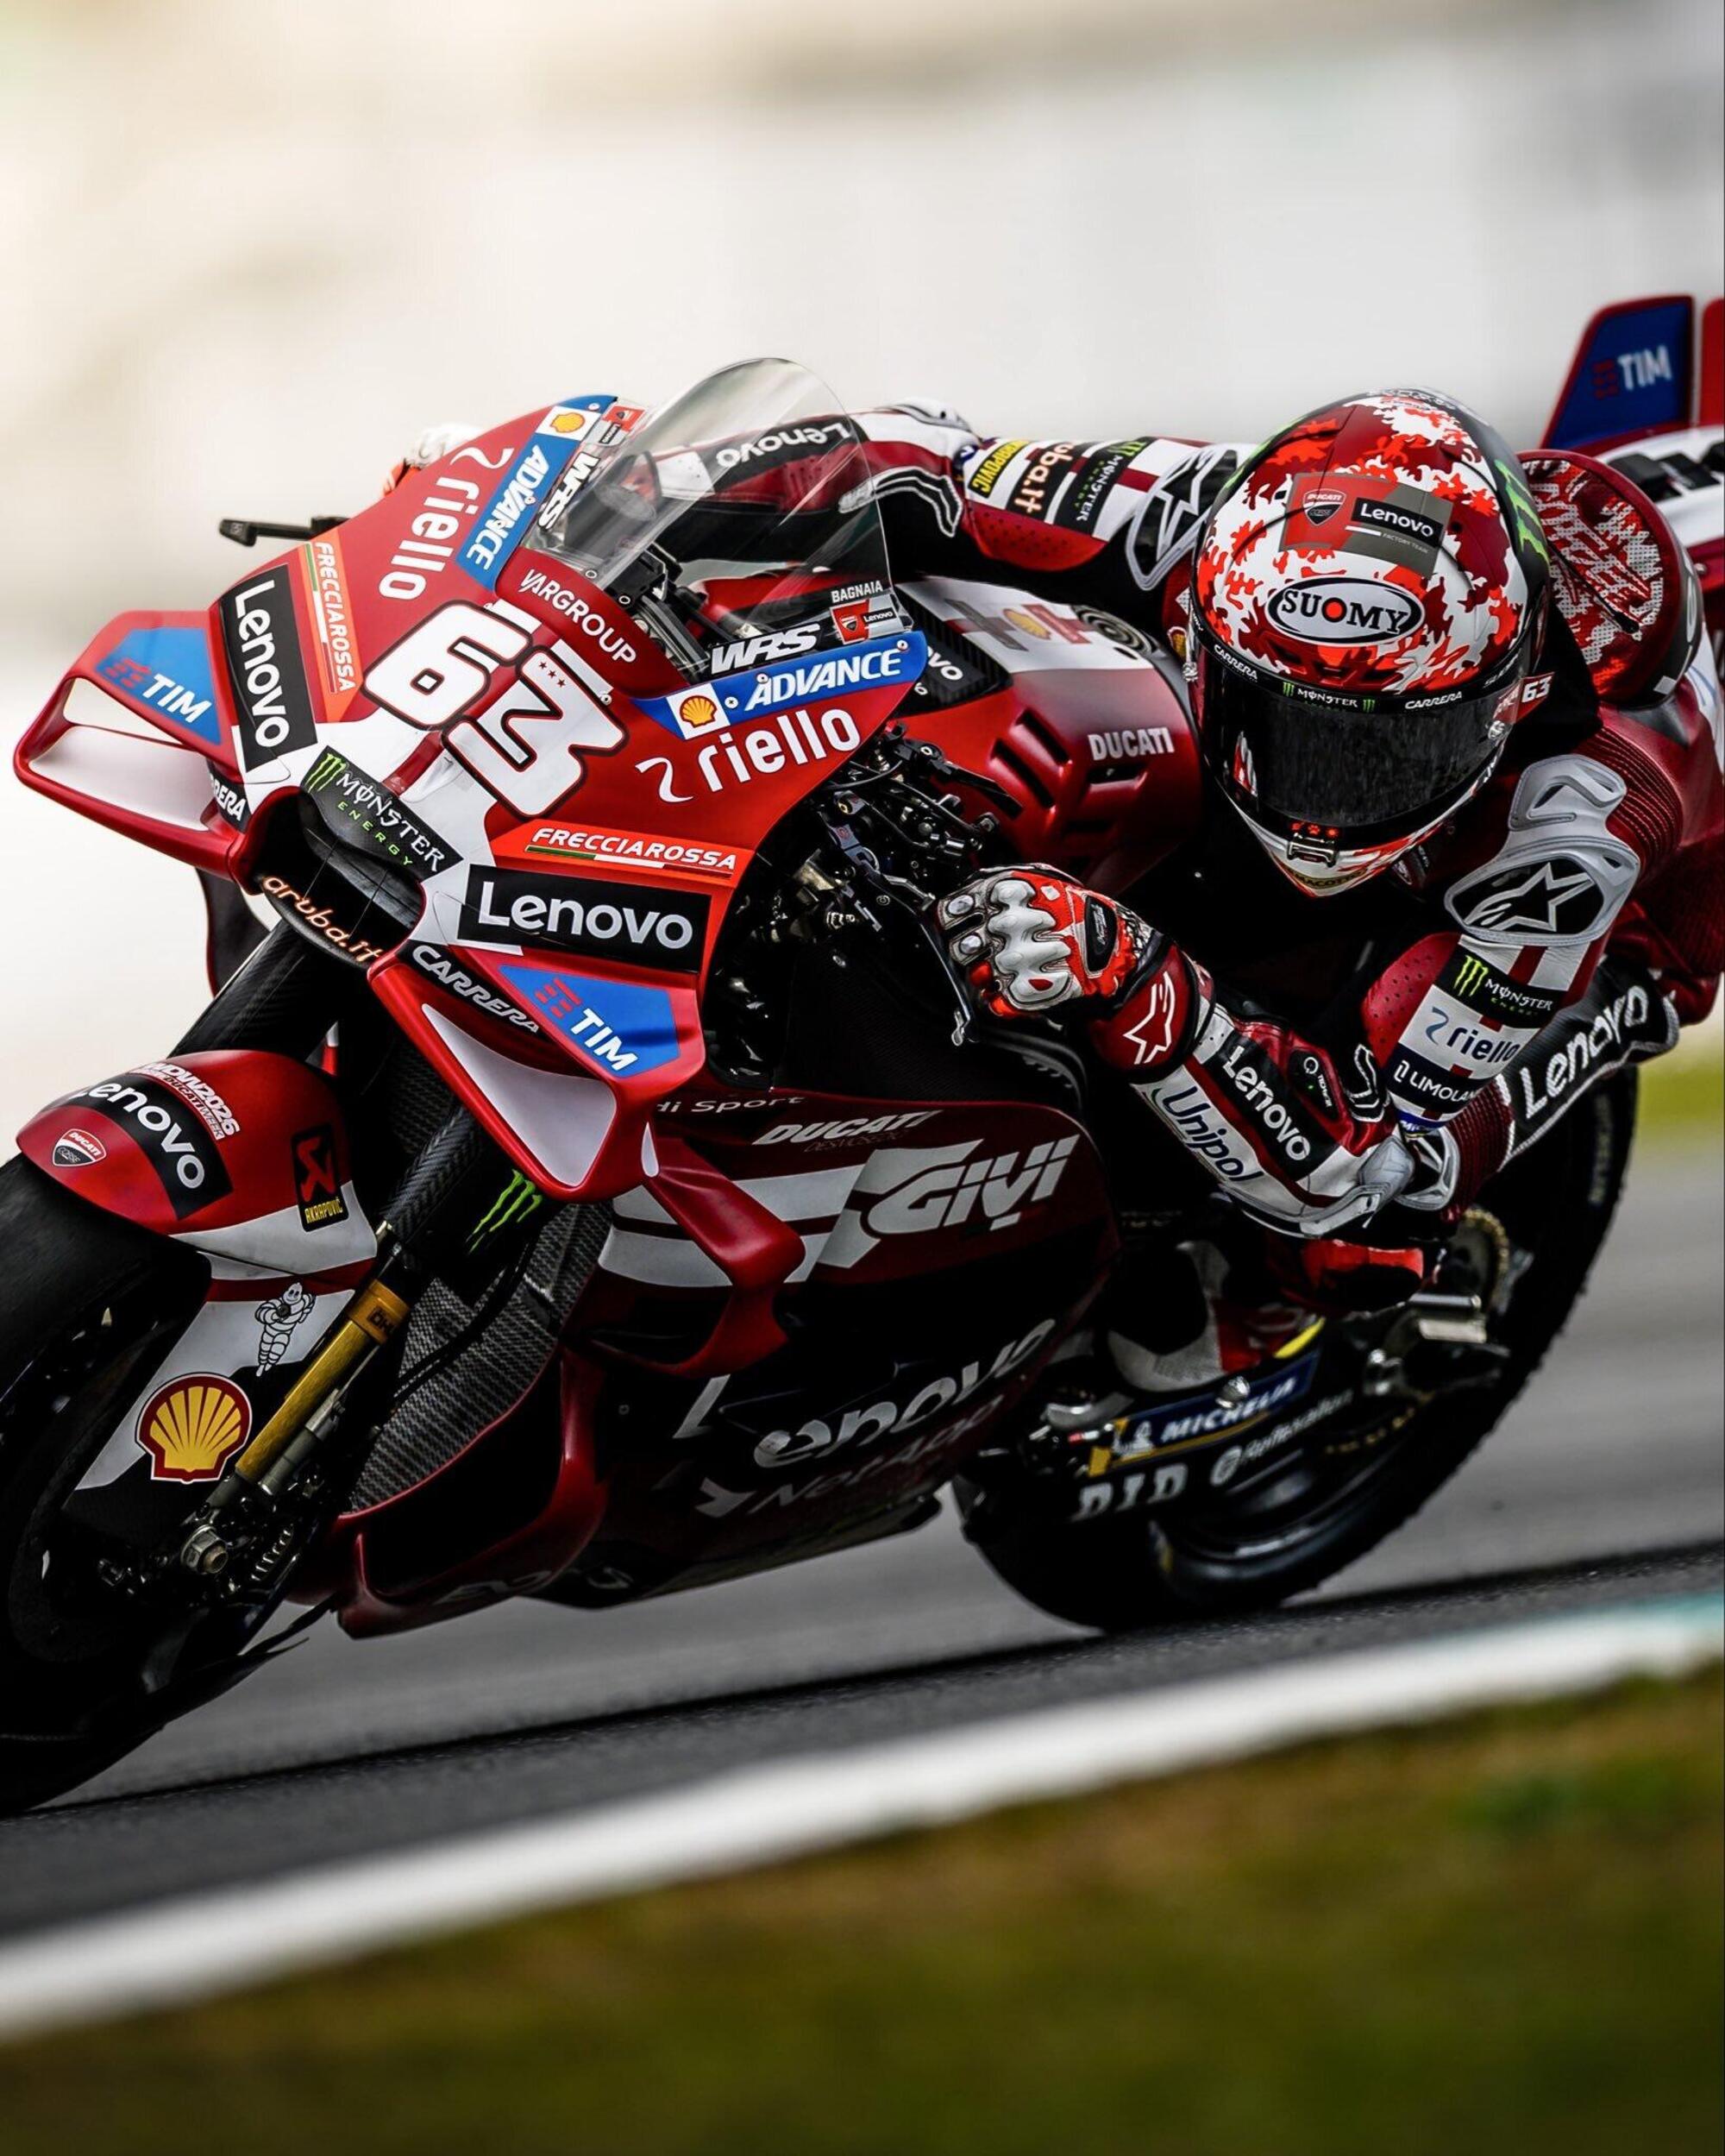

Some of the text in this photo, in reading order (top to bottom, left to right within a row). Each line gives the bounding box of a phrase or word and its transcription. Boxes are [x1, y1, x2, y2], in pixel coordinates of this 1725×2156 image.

[1617, 344, 1672, 392] TIM
[715, 423, 851, 468] Lenovo
[466, 444, 550, 570] ADVANCE
[1360, 502, 1433, 537] Lenovo
[380, 476, 480, 600] riello
[518, 568, 637, 664] VARGROUP
[831, 580, 884, 603] BAGNAIA
[1281, 591, 1413, 634] SUOMY
[315, 541, 356, 693] FRECCIAROSSA
[863, 611, 894, 623] Lenovo
[235, 580, 290, 748] Lenovo
[710, 623, 820, 675] WRS
[1214, 644, 1258, 680] CARRERA
[142, 674, 212, 724] TIM
[743, 648, 901, 712] ADVANCE
[1405, 691, 1462, 710] CARRERA
[1521, 676, 1552, 703] 63
[698, 707, 862, 793] riello
[1088, 726, 1176, 761] DUCATI
[337, 801, 413, 866] ENERGY
[531, 827, 737, 870] FRECCIAROSSA
[478, 881, 693, 949] Lenovo
[412, 945, 540, 1034] CARRERA
[570, 1008, 638, 1071] TIM
[1446, 1027, 1521, 1063] riello
[1519, 985, 1648, 1119] Lenovo
[691, 1097, 805, 1113] Sport
[751, 1109, 944, 1146] DUCATI
[1222, 1046, 1311, 1161] Lenovo
[69, 1132, 102, 1157] DUCATI
[1163, 1085, 1265, 1182] Unipol
